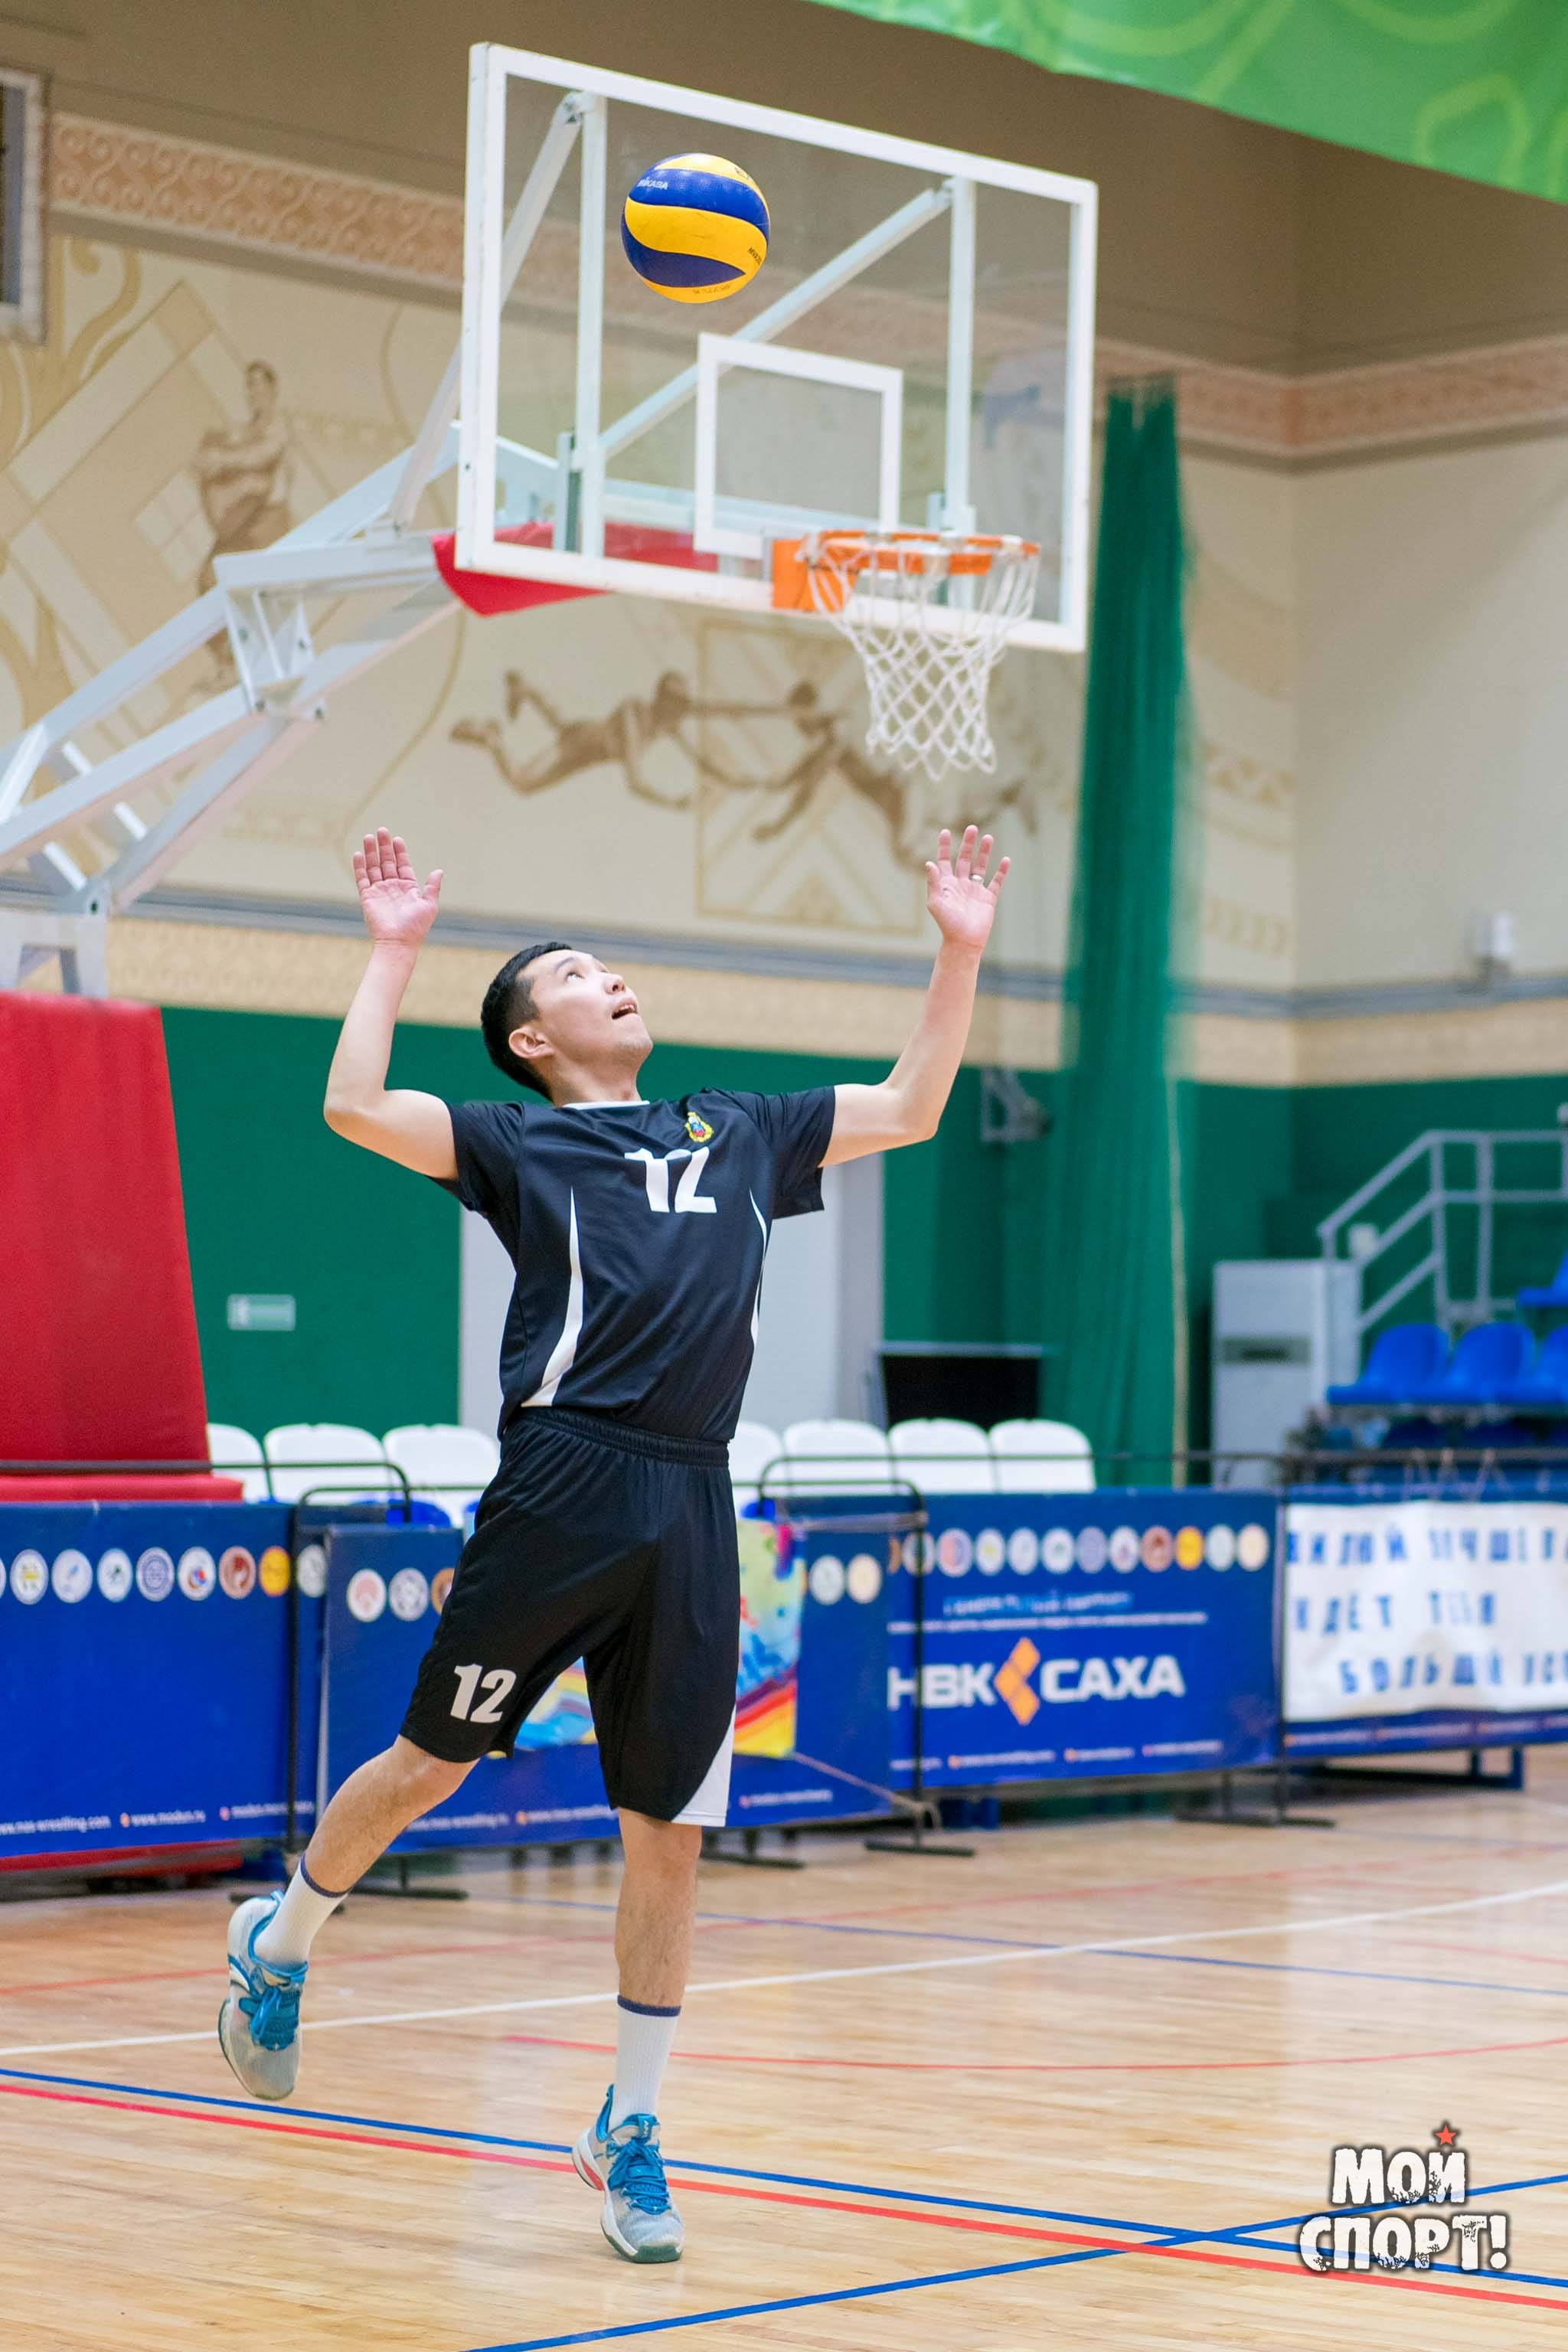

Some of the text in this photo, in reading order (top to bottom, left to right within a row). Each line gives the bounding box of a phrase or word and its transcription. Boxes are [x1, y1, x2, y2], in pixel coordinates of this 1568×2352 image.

[625, 1146, 717, 1213] 12
[450, 1664, 516, 1723] 12
[1040, 1654, 1186, 1704] САХА
